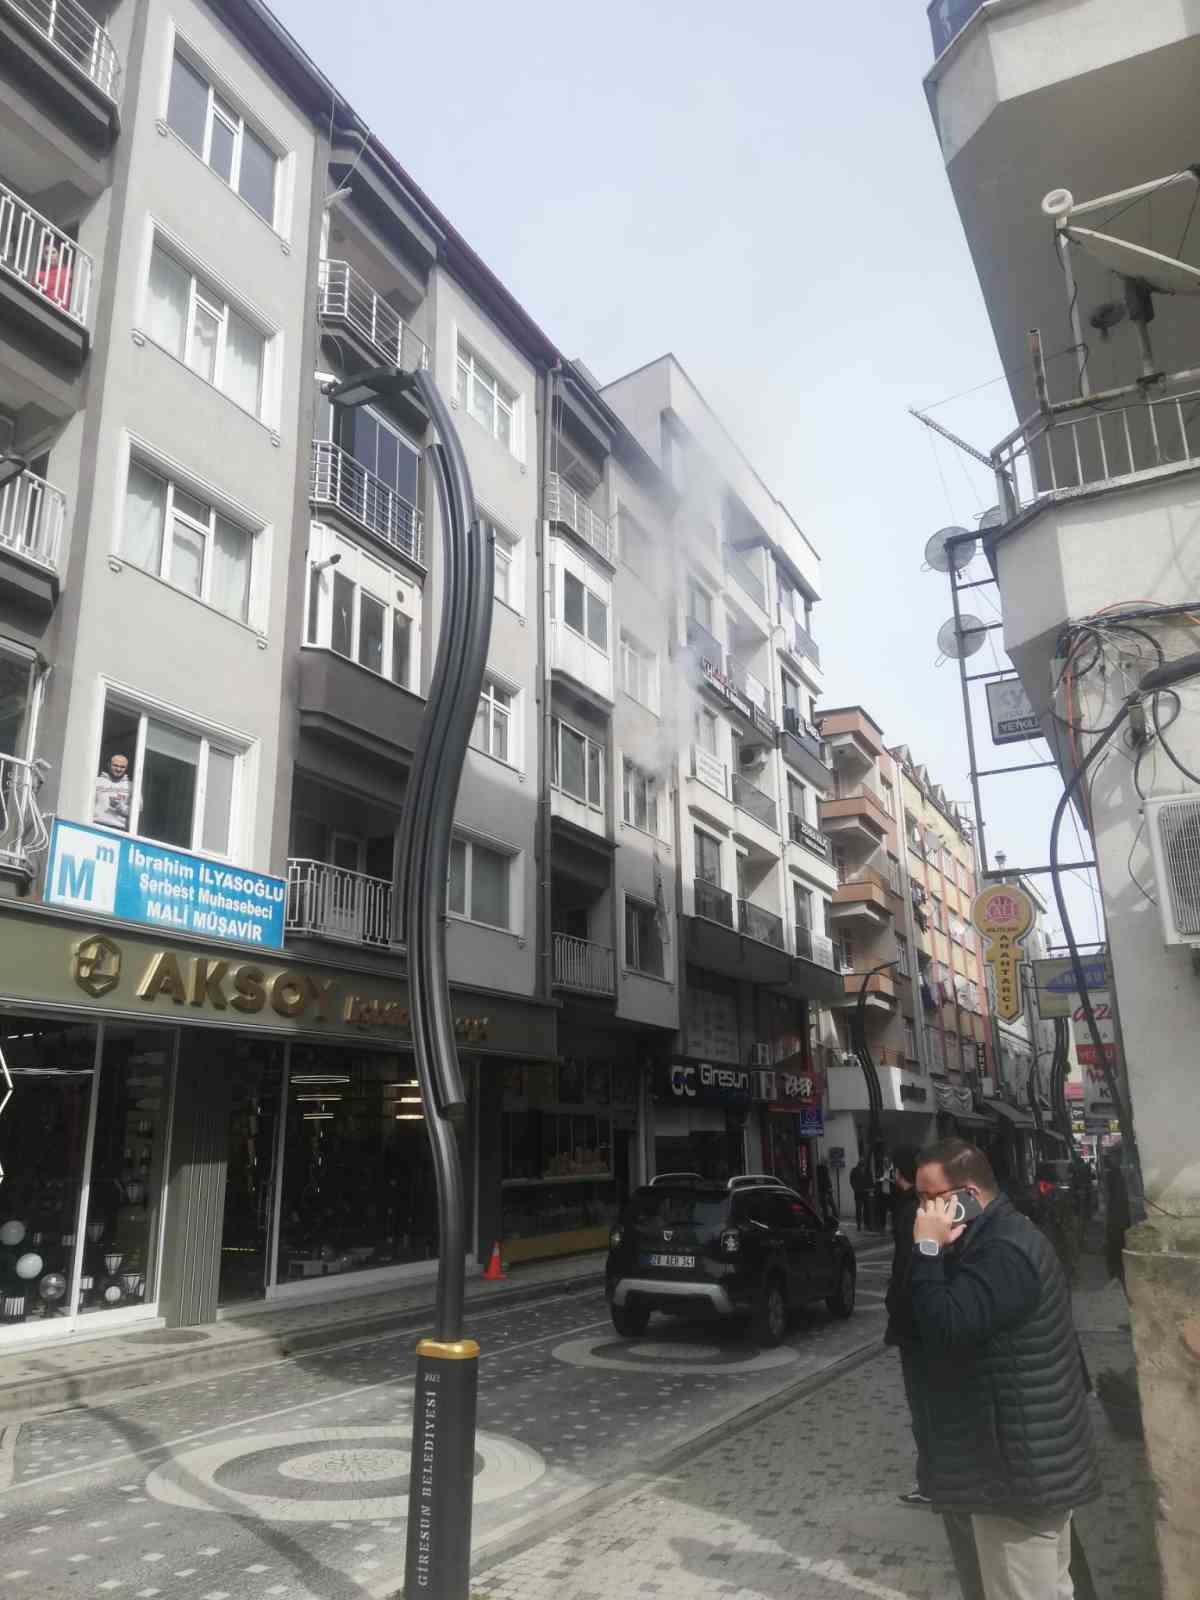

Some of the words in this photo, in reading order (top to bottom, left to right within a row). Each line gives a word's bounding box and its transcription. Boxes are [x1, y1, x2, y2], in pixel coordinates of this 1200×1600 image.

[58, 856, 96, 902] M
[127, 843, 194, 881] İbrahim
[198, 863, 284, 903] İLYASOĞLU
[138, 872, 195, 902] Serbest
[197, 887, 273, 920] Muhasebeci
[146, 900, 189, 926] MALİ
[193, 910, 263, 942] MÜŞAVİR
[136, 951, 336, 1022] AKSOY
[700, 1064, 749, 1088] Giresun
